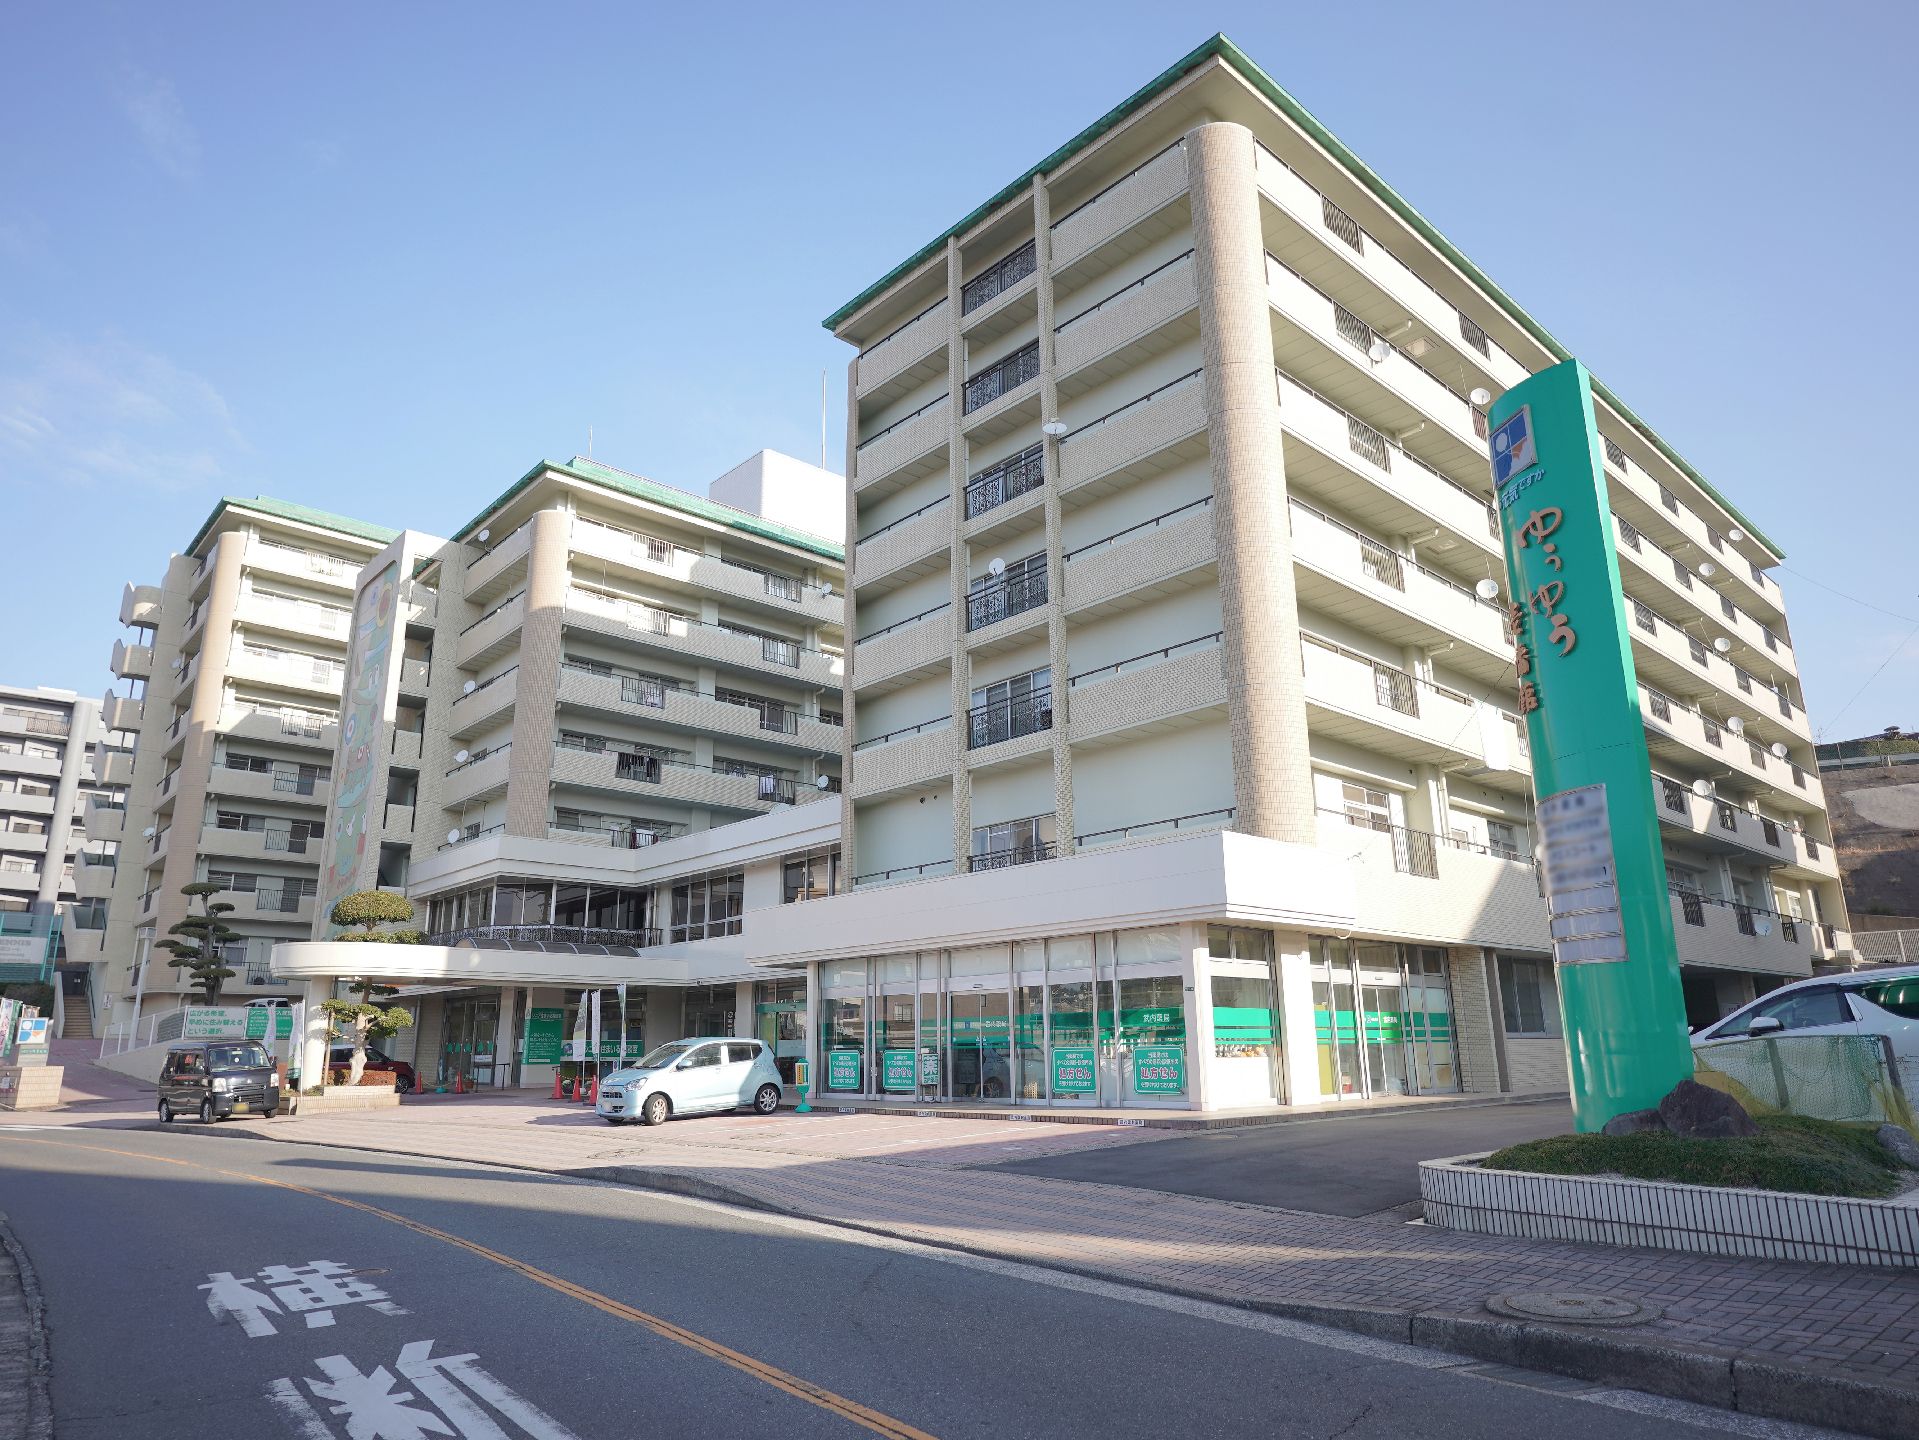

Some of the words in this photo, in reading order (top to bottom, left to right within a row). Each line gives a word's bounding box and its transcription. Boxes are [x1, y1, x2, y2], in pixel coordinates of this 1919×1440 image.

[1517, 507, 1577, 657] ゆうゆう
[1058, 1067, 1092, 1080] 処方せん
[1140, 1067, 1178, 1080] 処方せん
